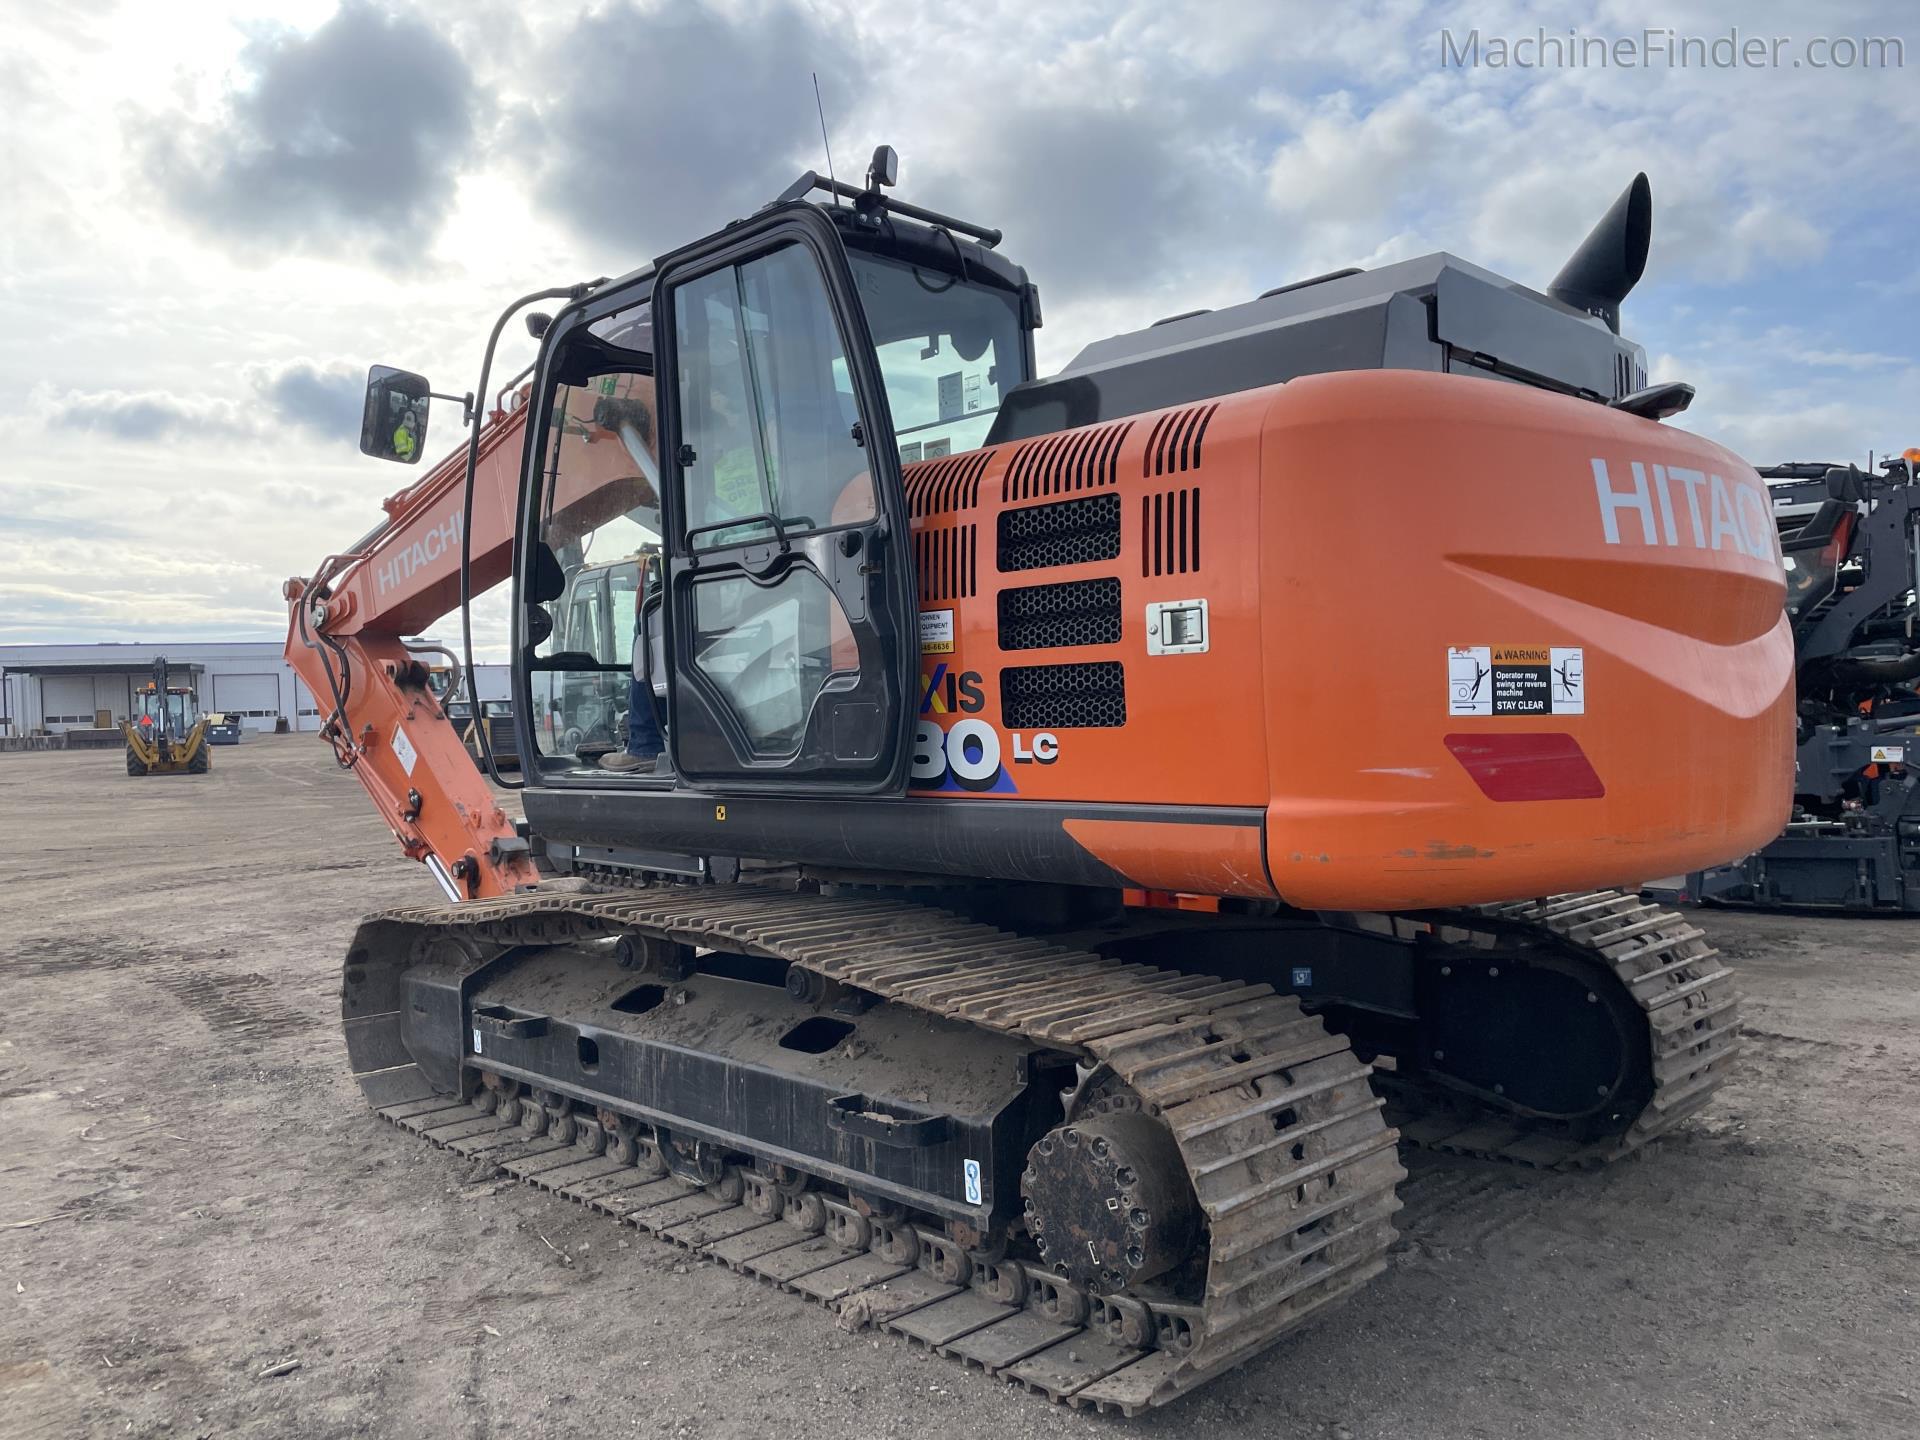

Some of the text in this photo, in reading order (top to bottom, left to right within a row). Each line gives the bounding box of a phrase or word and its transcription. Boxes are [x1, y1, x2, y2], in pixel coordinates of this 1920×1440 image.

[377, 510, 463, 595] HITACHI
[921, 622, 948, 630] QUIPMENT
[1504, 650, 1548, 660] WARNING
[1496, 671, 1524, 680] Operator
[920, 663, 985, 714] XIS
[1496, 689, 1523, 697] machine
[1497, 701, 1544, 710] STAY CLEAR
[910, 719, 1059, 788] 80 LC
